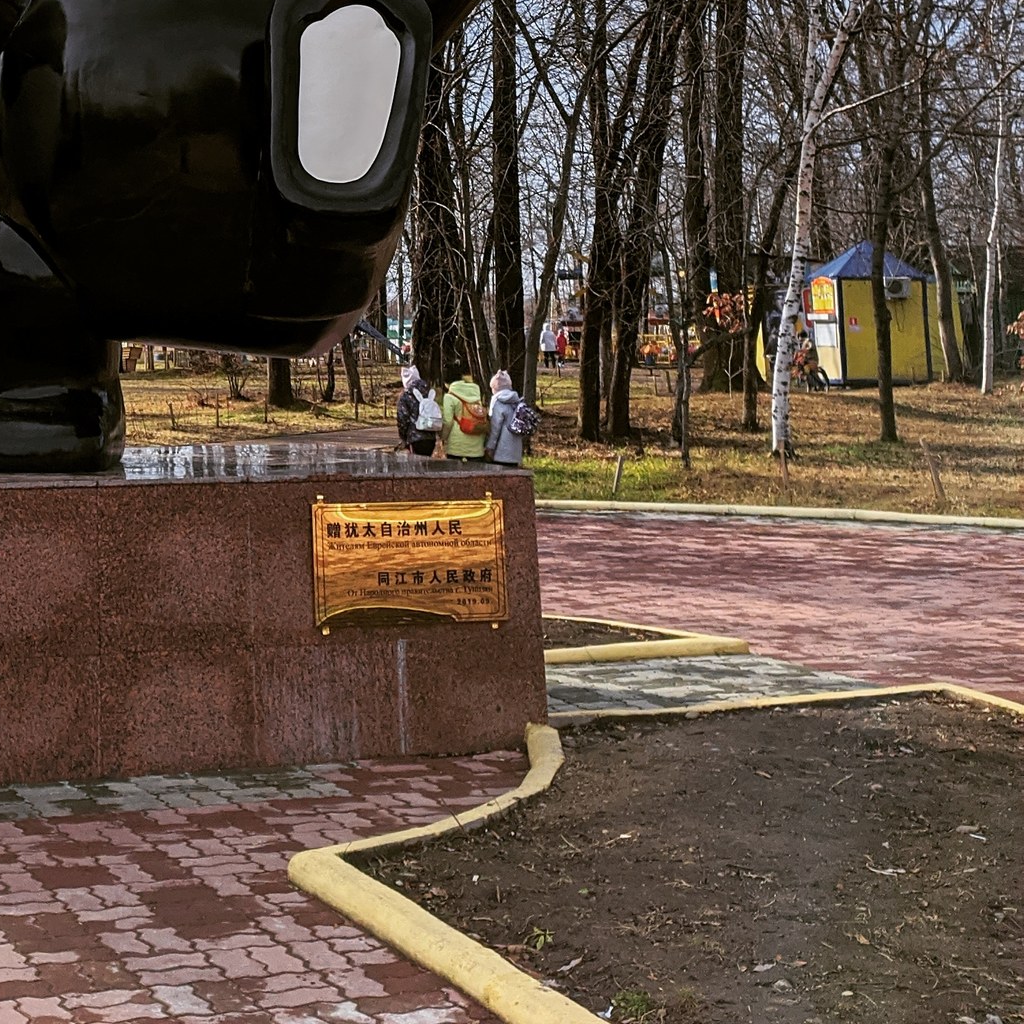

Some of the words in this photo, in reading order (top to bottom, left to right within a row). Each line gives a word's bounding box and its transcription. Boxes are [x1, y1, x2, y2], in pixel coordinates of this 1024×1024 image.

[326, 520, 462, 538] 赠犹太自治州人民
[366, 540, 410, 550] Еврейской
[412, 538, 459, 548] автономной
[460, 537, 492, 547] области
[378, 568, 493, 586] 同江市人民政府
